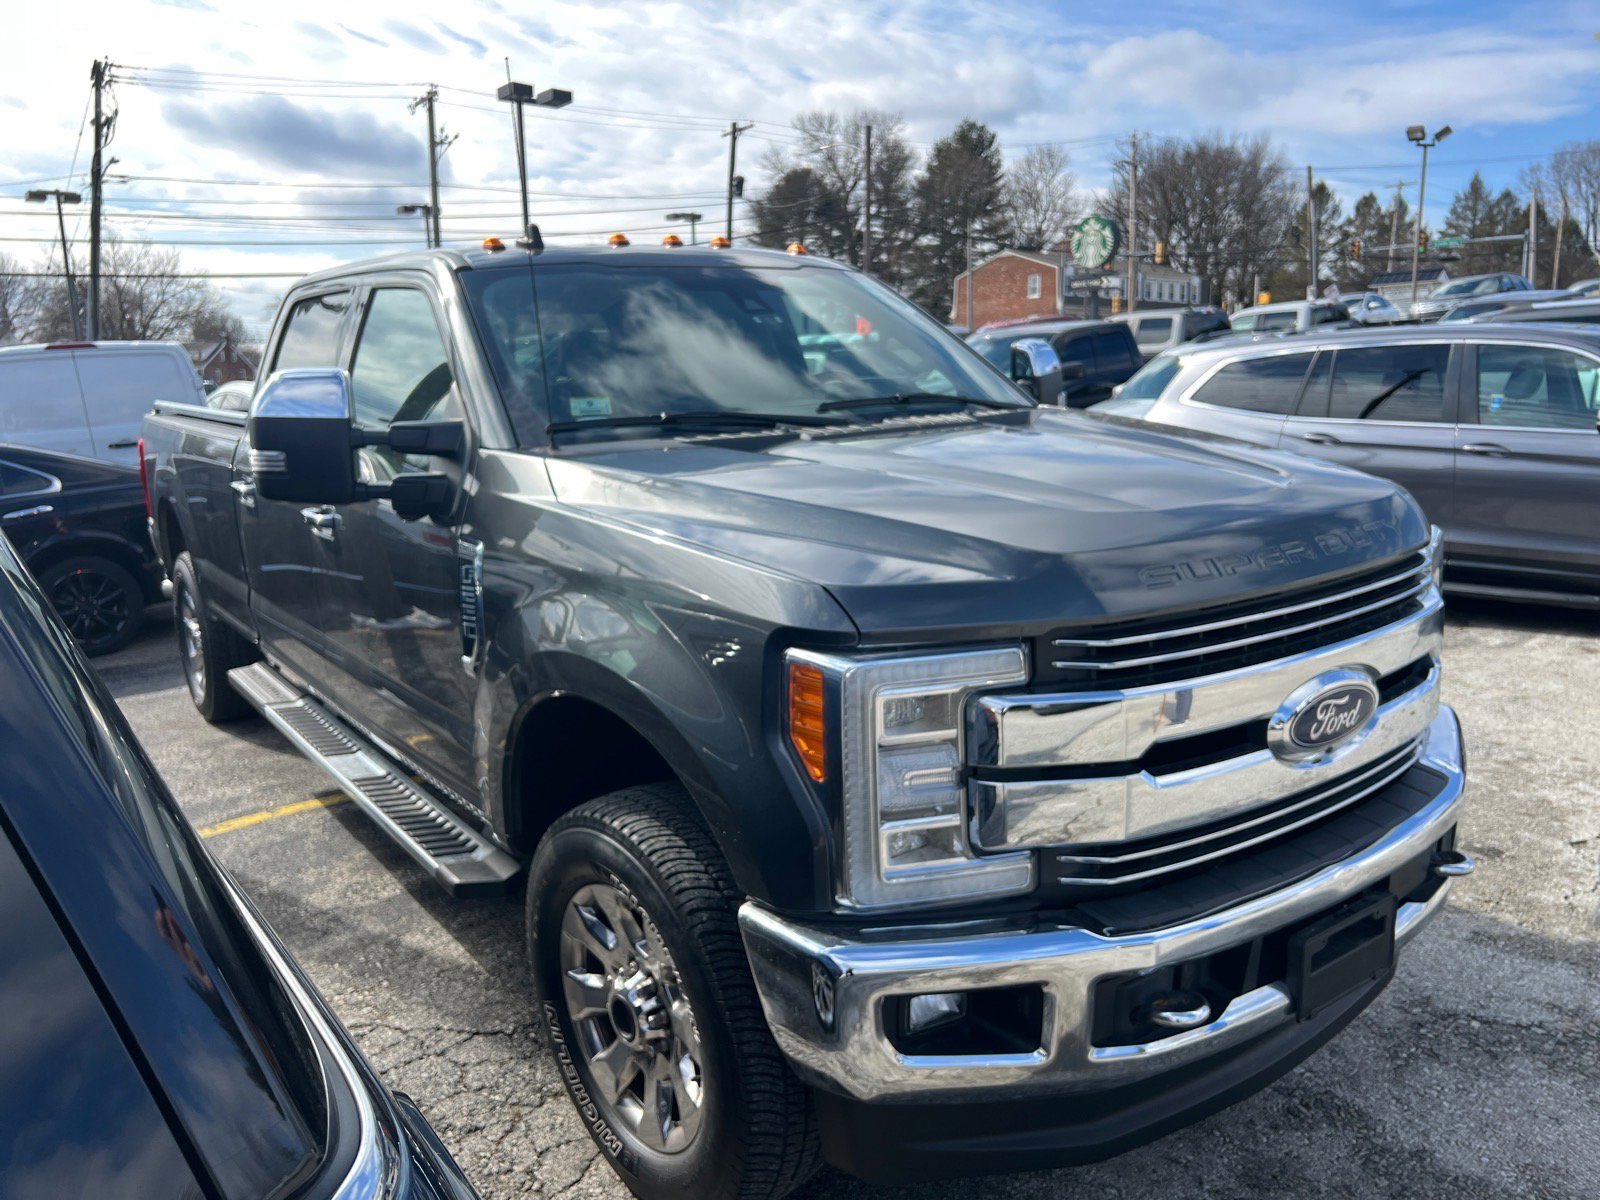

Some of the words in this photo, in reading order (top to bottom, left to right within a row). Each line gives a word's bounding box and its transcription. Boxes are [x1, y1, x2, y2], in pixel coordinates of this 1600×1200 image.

[1137, 539, 1319, 590] SUPER
[1314, 519, 1400, 555] DUTY
[1309, 694, 1362, 741] Ford
[543, 1003, 624, 1158] MICHELIN
